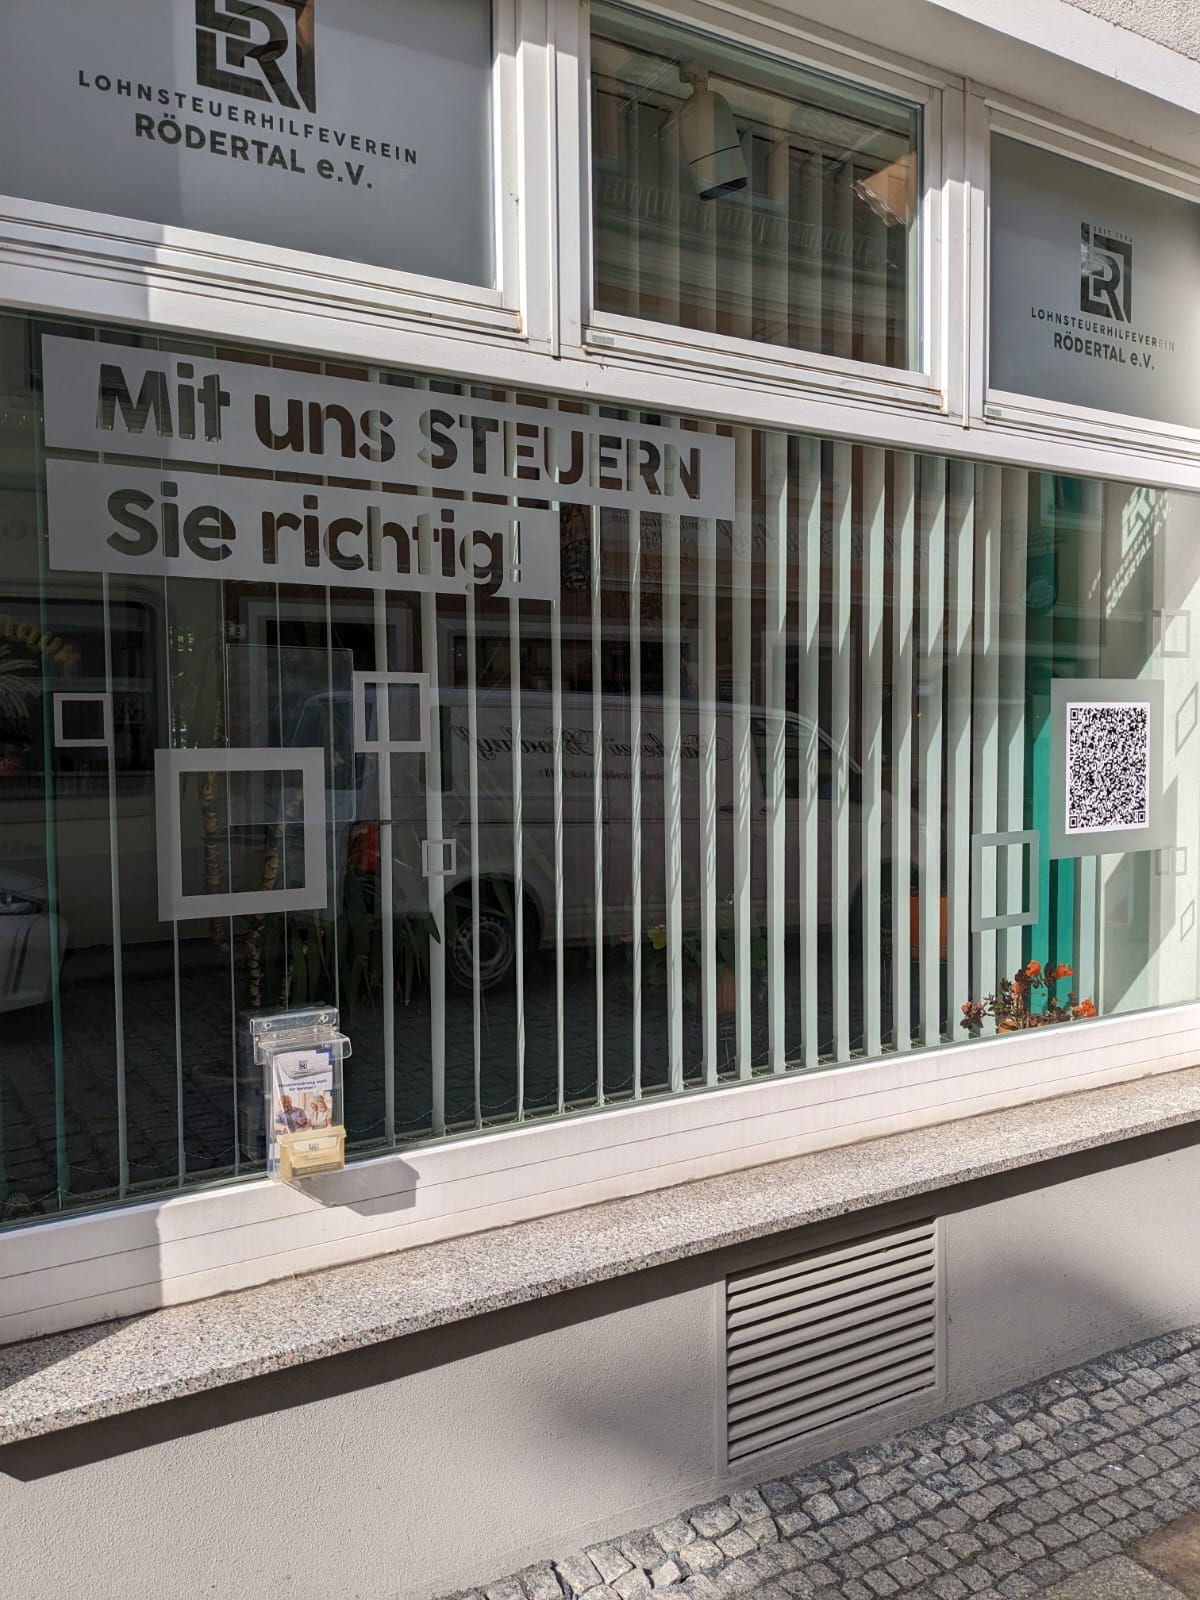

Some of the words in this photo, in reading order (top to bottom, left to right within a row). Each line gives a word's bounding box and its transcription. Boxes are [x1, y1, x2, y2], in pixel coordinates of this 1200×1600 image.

[78, 69, 417, 165] LOHNSTEUERHILFEVEREIN
[135, 112, 306, 175] RÖDERTAL
[316, 158, 373, 189] e.V.
[1031, 306, 1175, 353] LOHNSTEUERHILFEVEREIN
[1053, 331, 1126, 365] RÖDERTAL
[1130, 352, 1155, 371] e.V.
[96, 362, 231, 443] Mit
[255, 394, 396, 463] uns
[417, 409, 701, 500] STEUERN
[106, 481, 237, 562] Sie
[262, 494, 521, 597] richtig!
